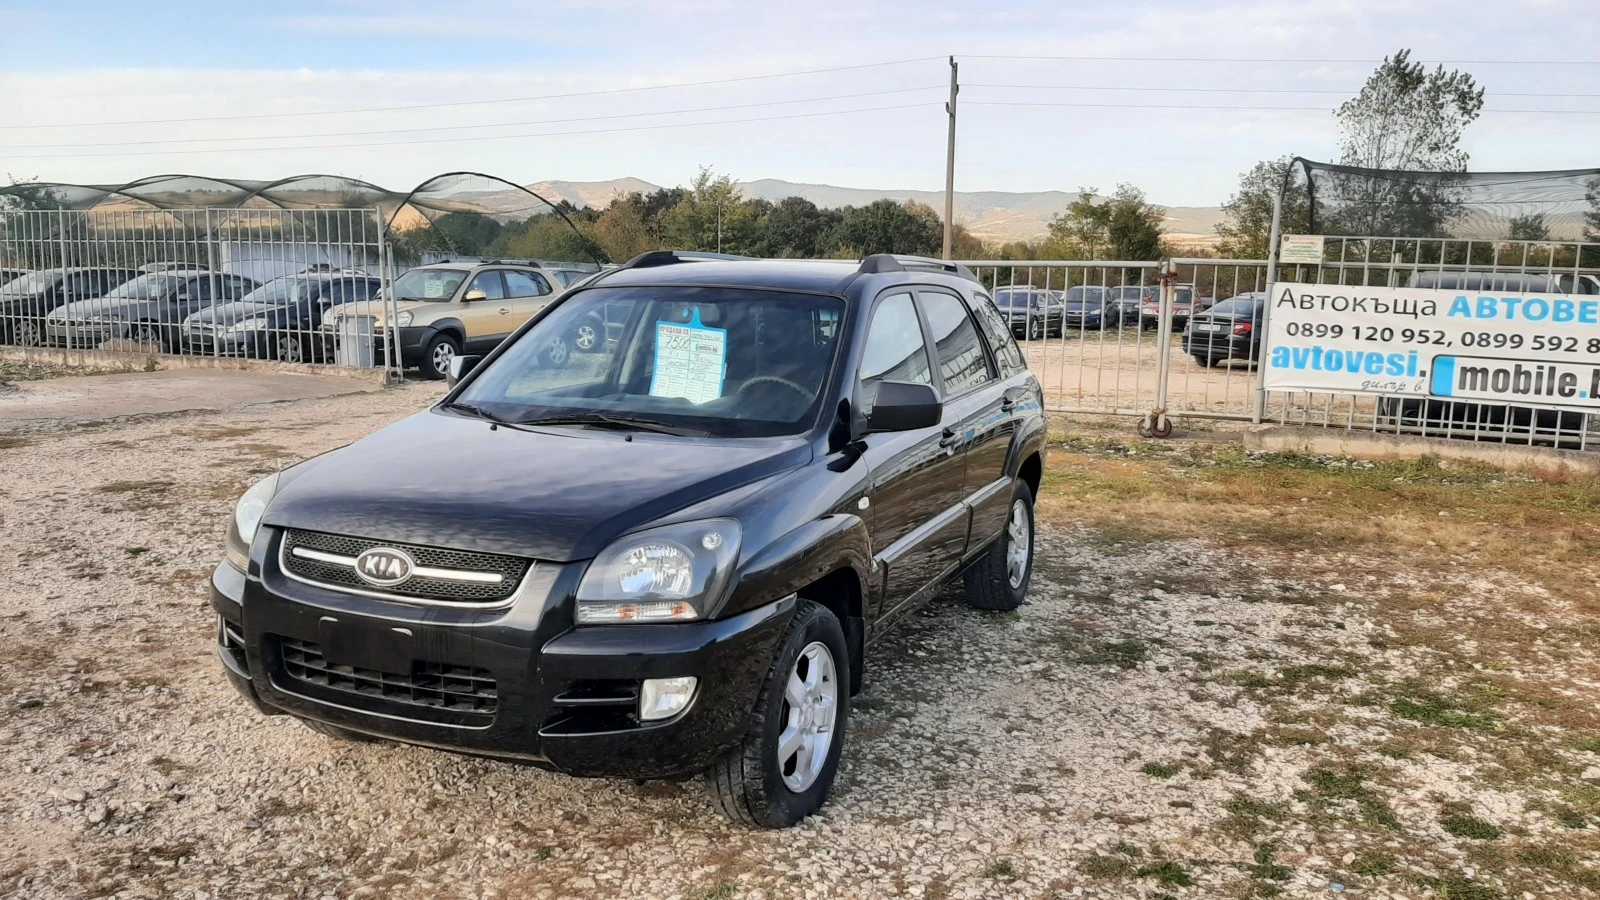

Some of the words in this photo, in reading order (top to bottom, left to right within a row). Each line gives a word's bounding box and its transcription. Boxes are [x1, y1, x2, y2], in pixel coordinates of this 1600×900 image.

[1277, 288, 1437, 319] Автокъща
[1286, 322, 1344, 339] 0899
[1351, 325, 1394, 342] 120
[1461, 331, 1524, 349] 0899
[1532, 335, 1579, 353] 592
[1361, 380, 1407, 393] дилър
[364, 555, 401, 577] KIA
